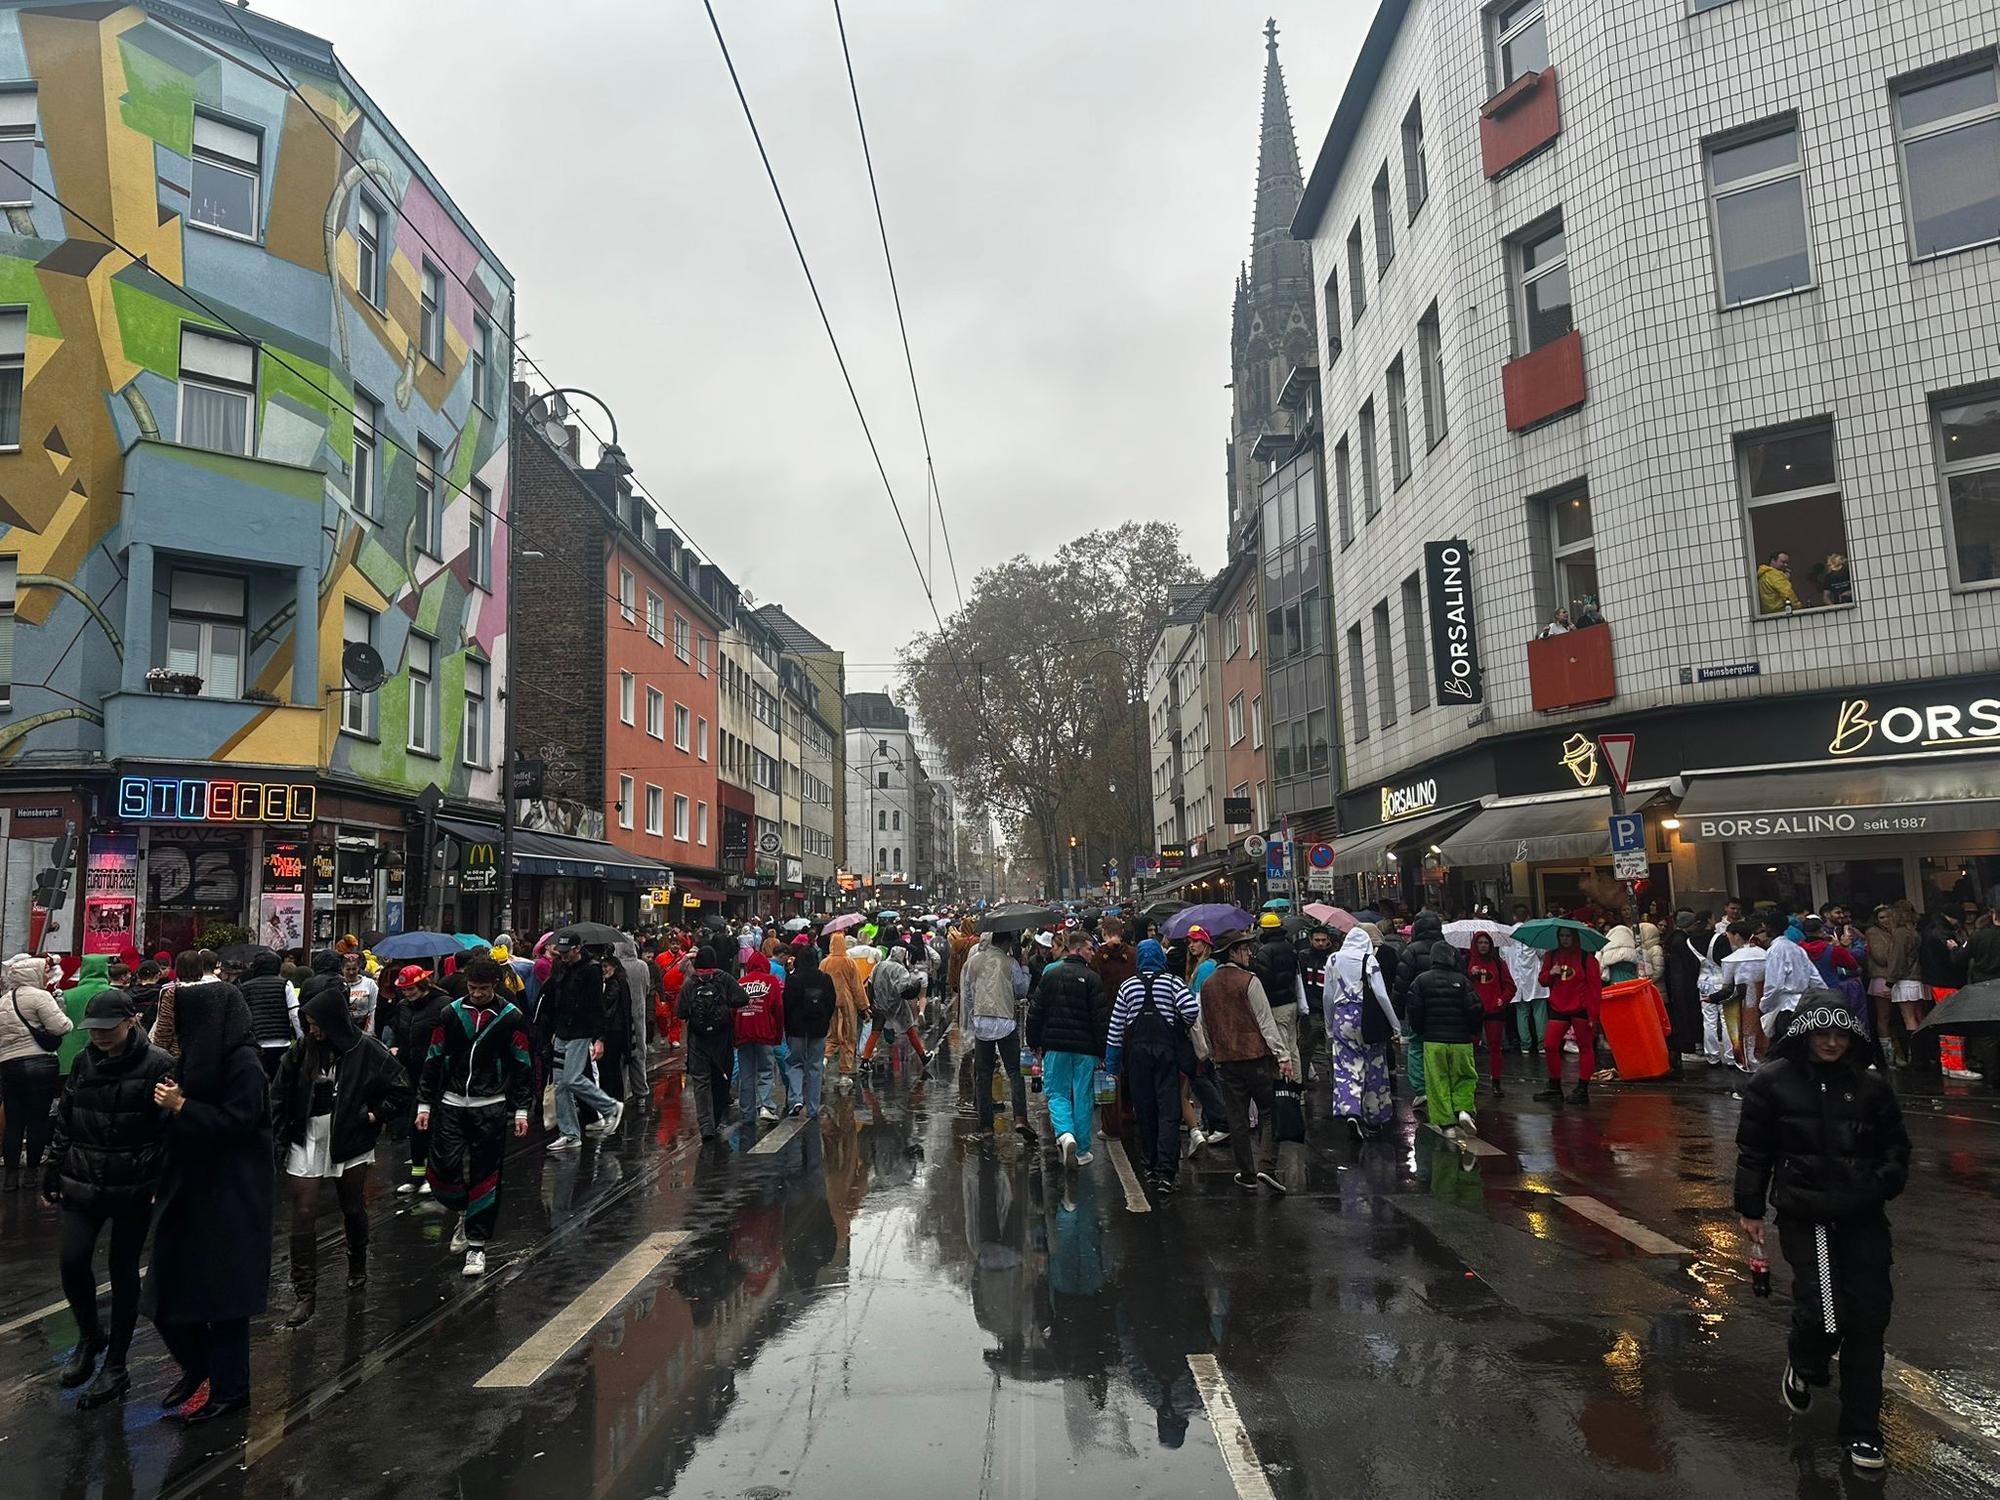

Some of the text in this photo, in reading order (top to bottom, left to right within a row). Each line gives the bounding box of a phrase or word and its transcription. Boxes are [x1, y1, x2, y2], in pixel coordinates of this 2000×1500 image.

[1441, 548, 1473, 699] BORSALINO
[1703, 665, 1755, 678] Heinsbergstr.
[125, 783, 309, 817] STIEFEL
[1381, 778, 1437, 822] BORSALINO
[1617, 819, 1635, 847] P
[1700, 813, 1927, 837] BORSALINO seit 1987
[263, 856, 302, 866] FANTA
[273, 868, 301, 877] VIER
